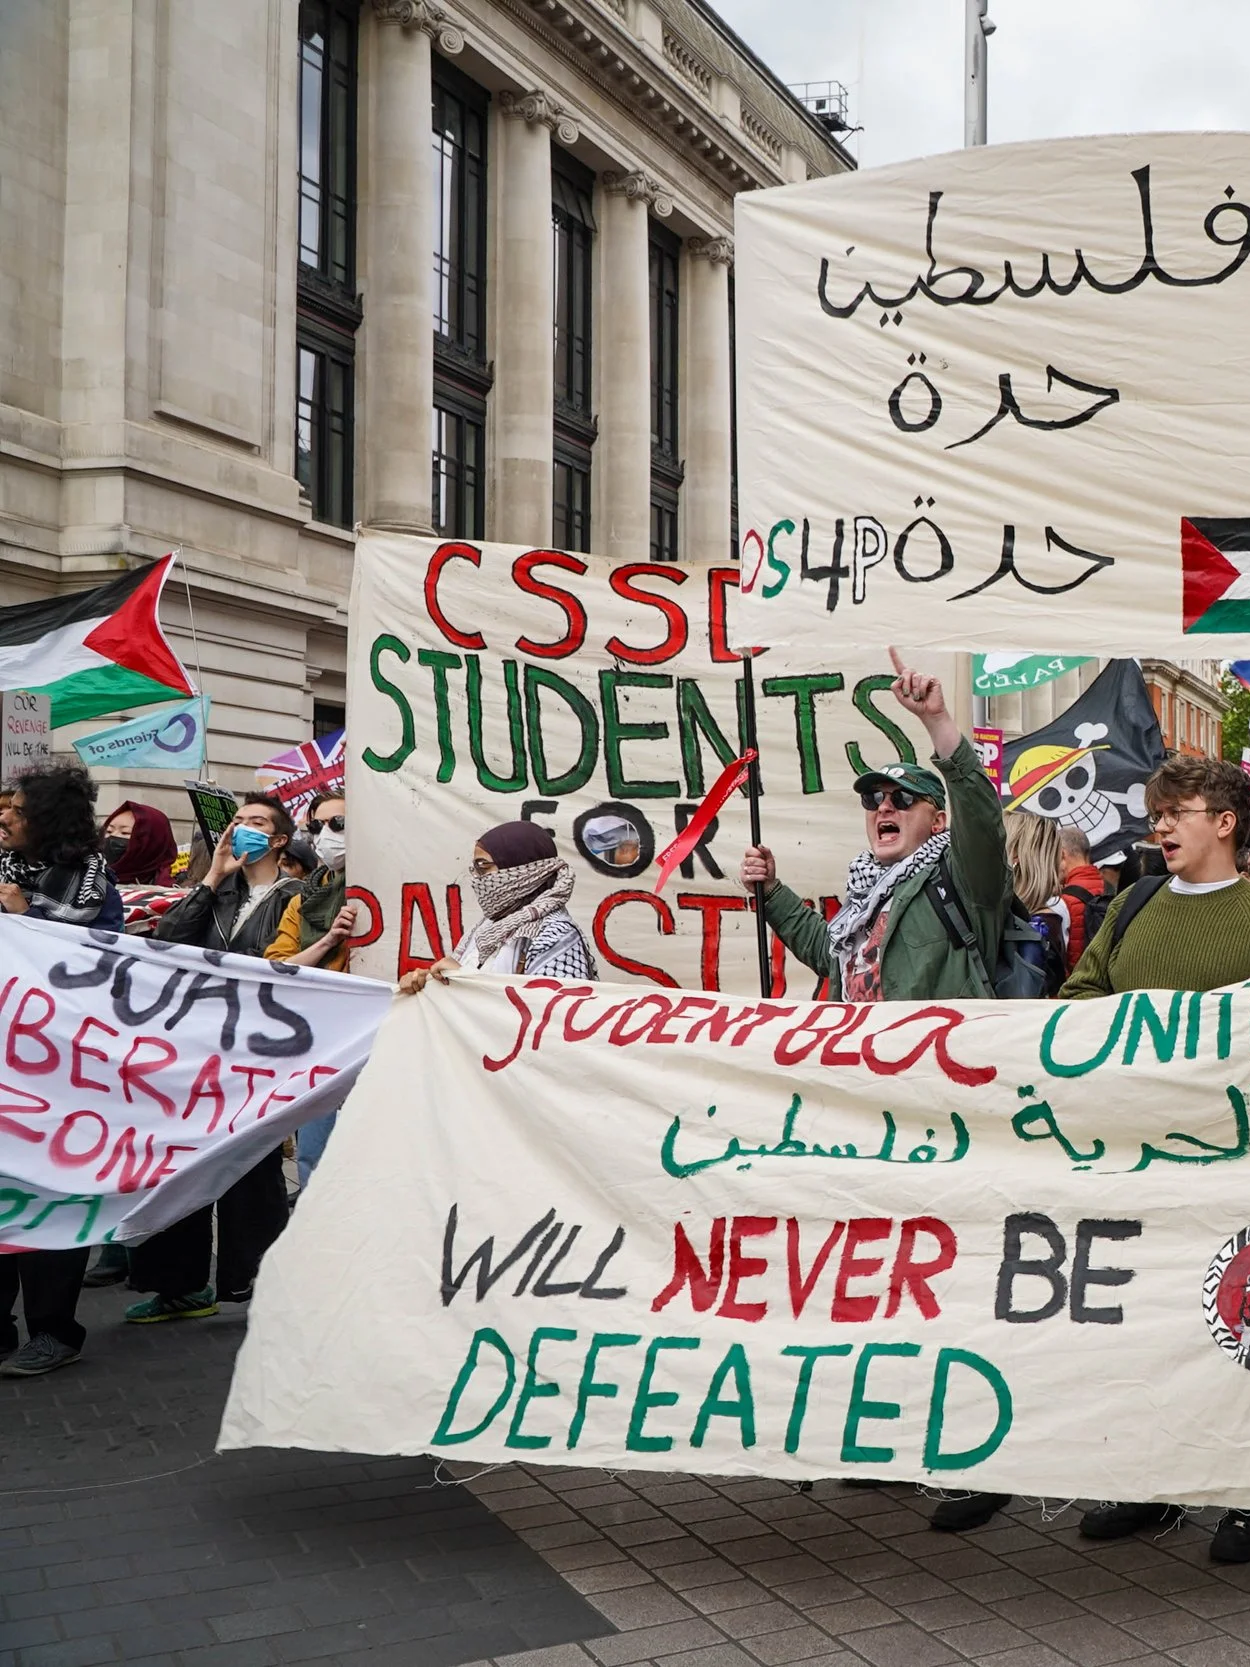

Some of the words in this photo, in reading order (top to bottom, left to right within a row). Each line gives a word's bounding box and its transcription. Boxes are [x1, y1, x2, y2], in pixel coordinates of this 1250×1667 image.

[887, 352, 1120, 450] حرة
[892, 496, 1115, 602] حرة
[7, 715, 48, 736] REVENGE
[14, 695, 38, 712] OUR
[362, 633, 917, 801] STUDENTS
[520, 799, 727, 879] FOR
[661, 1093, 970, 1179] لفلسطين
[440, 1203, 627, 1307] WILL
[650, 1214, 957, 1323] NEVER
[994, 1212, 1143, 1324] BE
[430, 1327, 1014, 1471] DEFEATED
